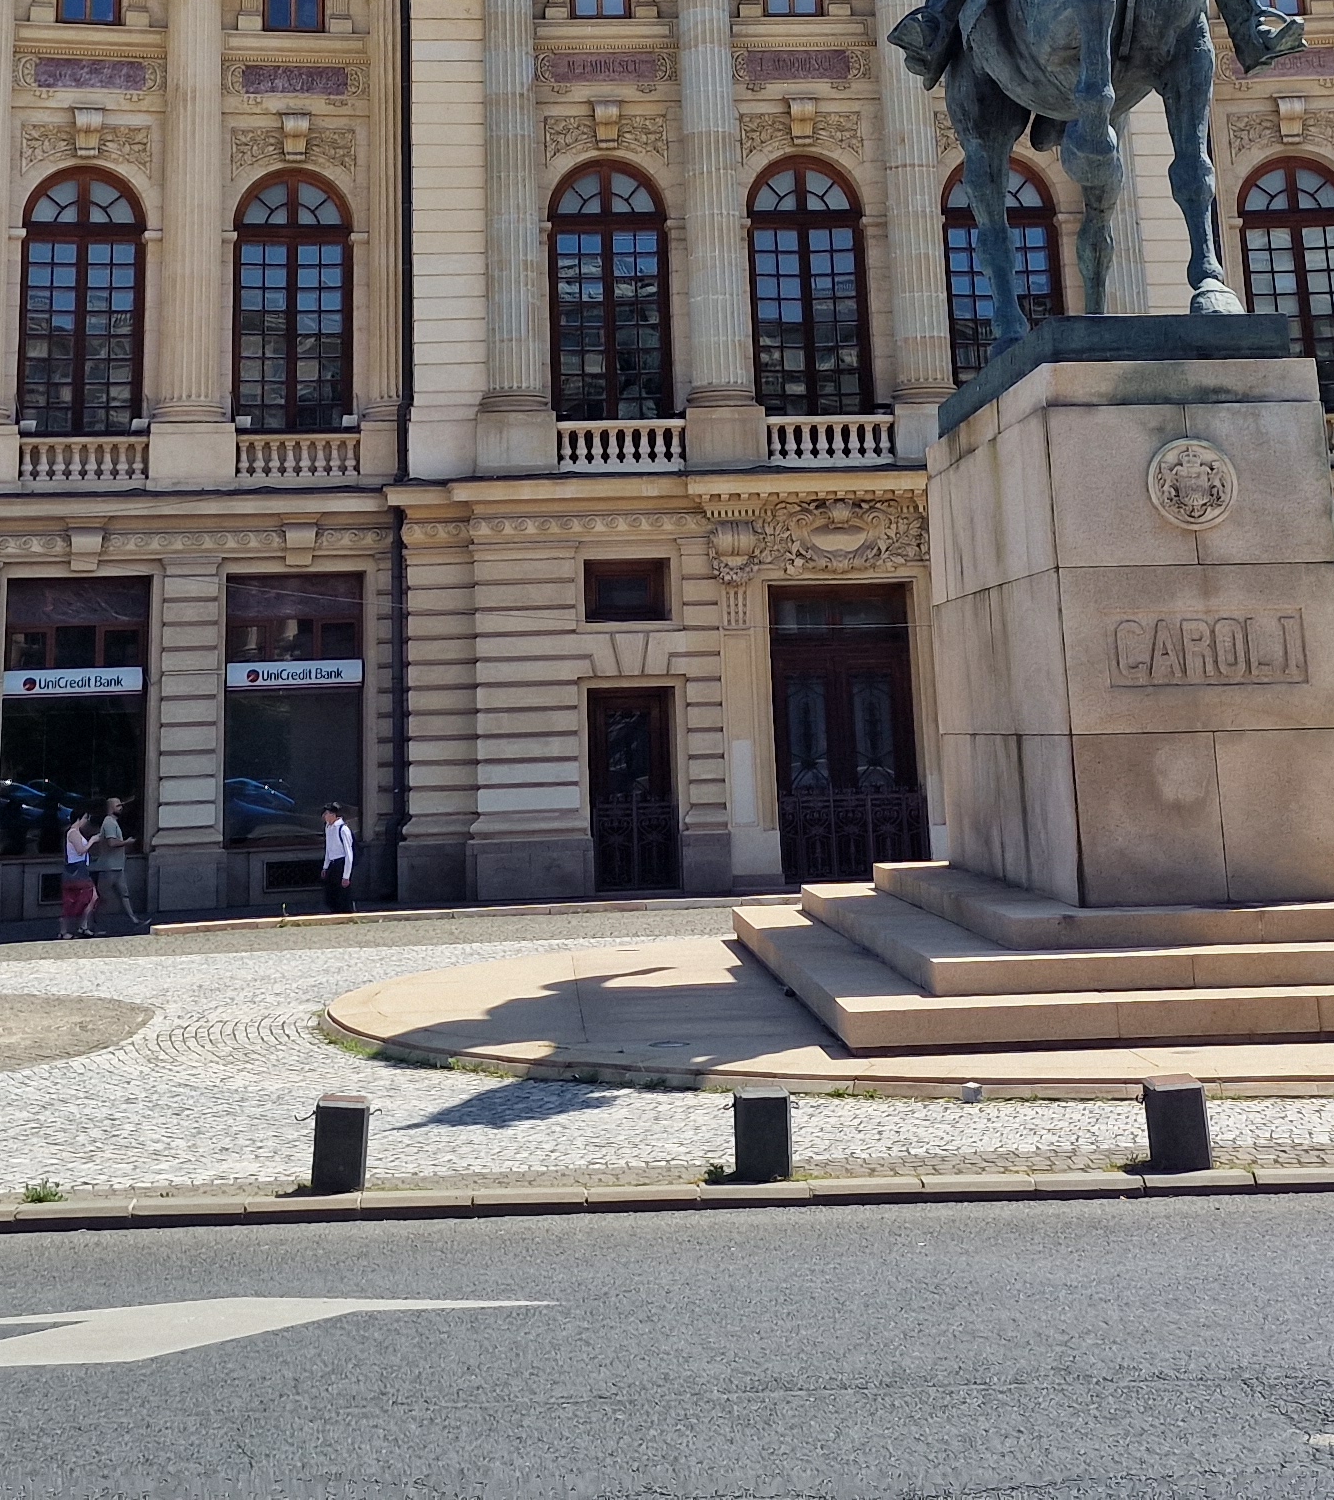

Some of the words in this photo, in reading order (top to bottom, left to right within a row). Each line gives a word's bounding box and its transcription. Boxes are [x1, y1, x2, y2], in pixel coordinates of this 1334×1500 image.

[261, 668, 312, 682] UniCredit
[315, 667, 343, 680] Bank
[38, 675, 93, 690] UniCredit
[94, 675, 123, 688] Bank
